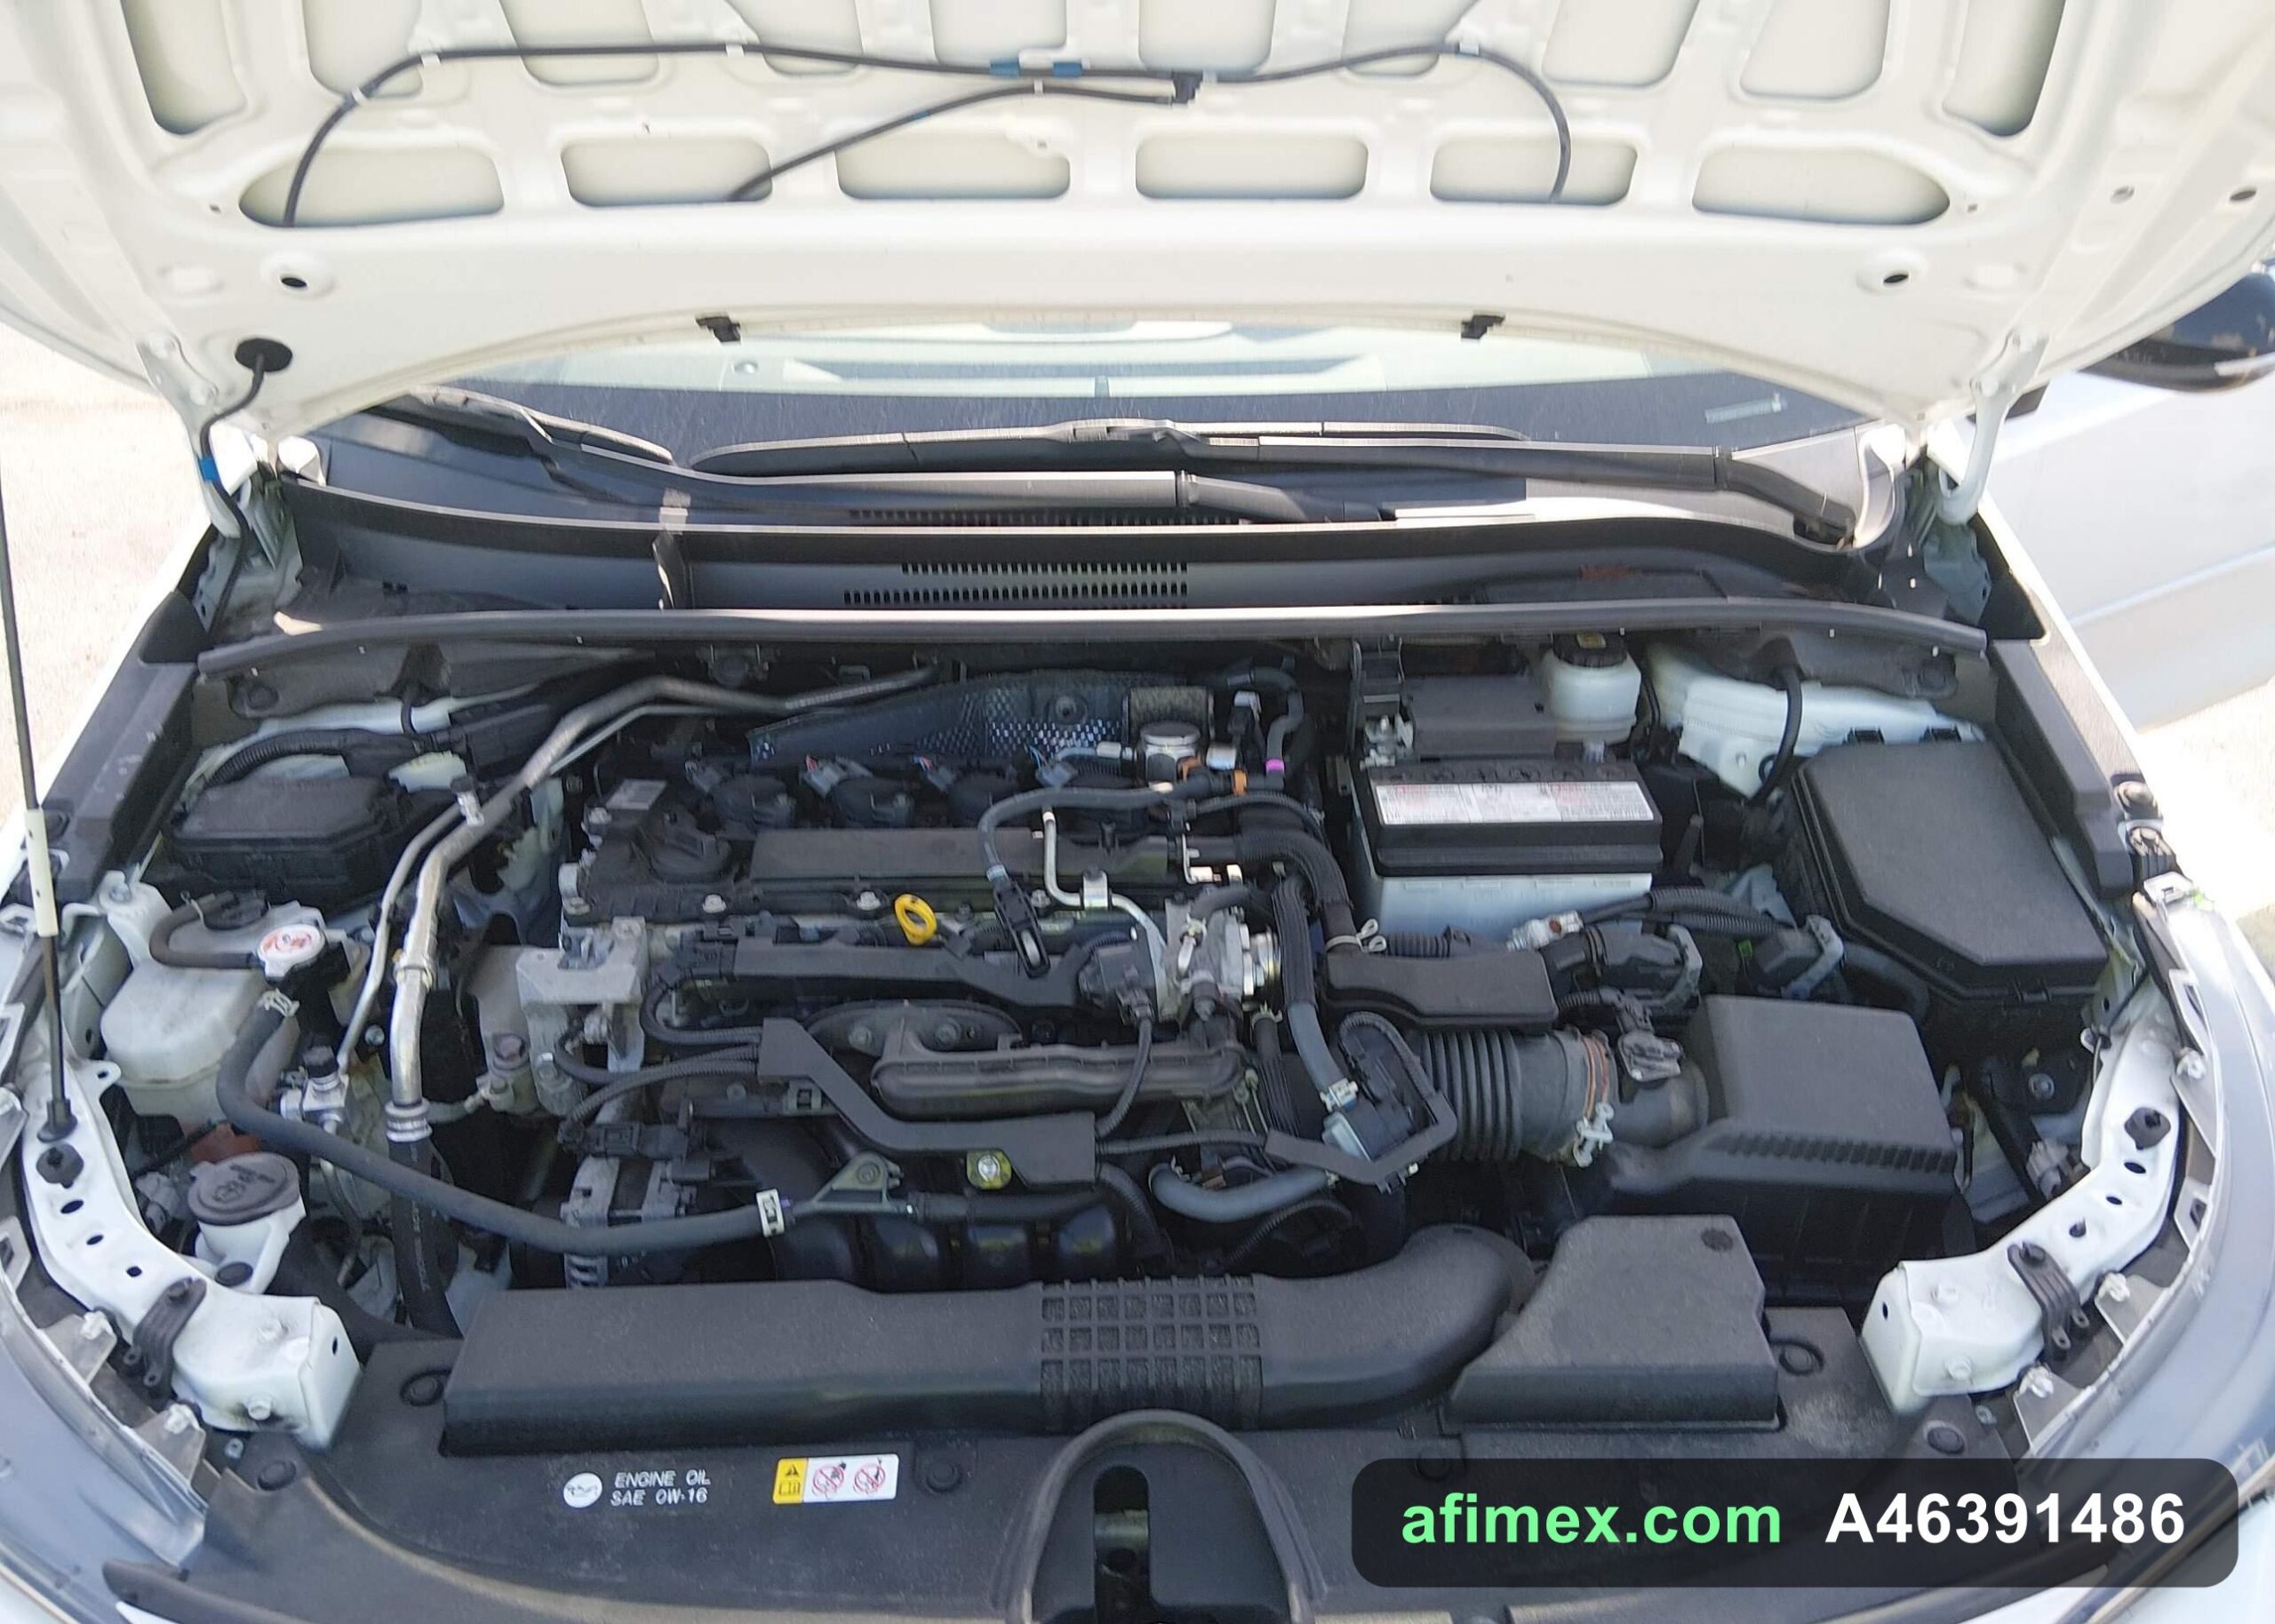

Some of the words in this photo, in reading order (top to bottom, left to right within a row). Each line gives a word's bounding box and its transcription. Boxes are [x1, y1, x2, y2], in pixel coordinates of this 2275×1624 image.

[614, 1470, 676, 1488] ENGINE
[685, 1469, 711, 1486] OIL
[611, 1490, 646, 1507] SAE
